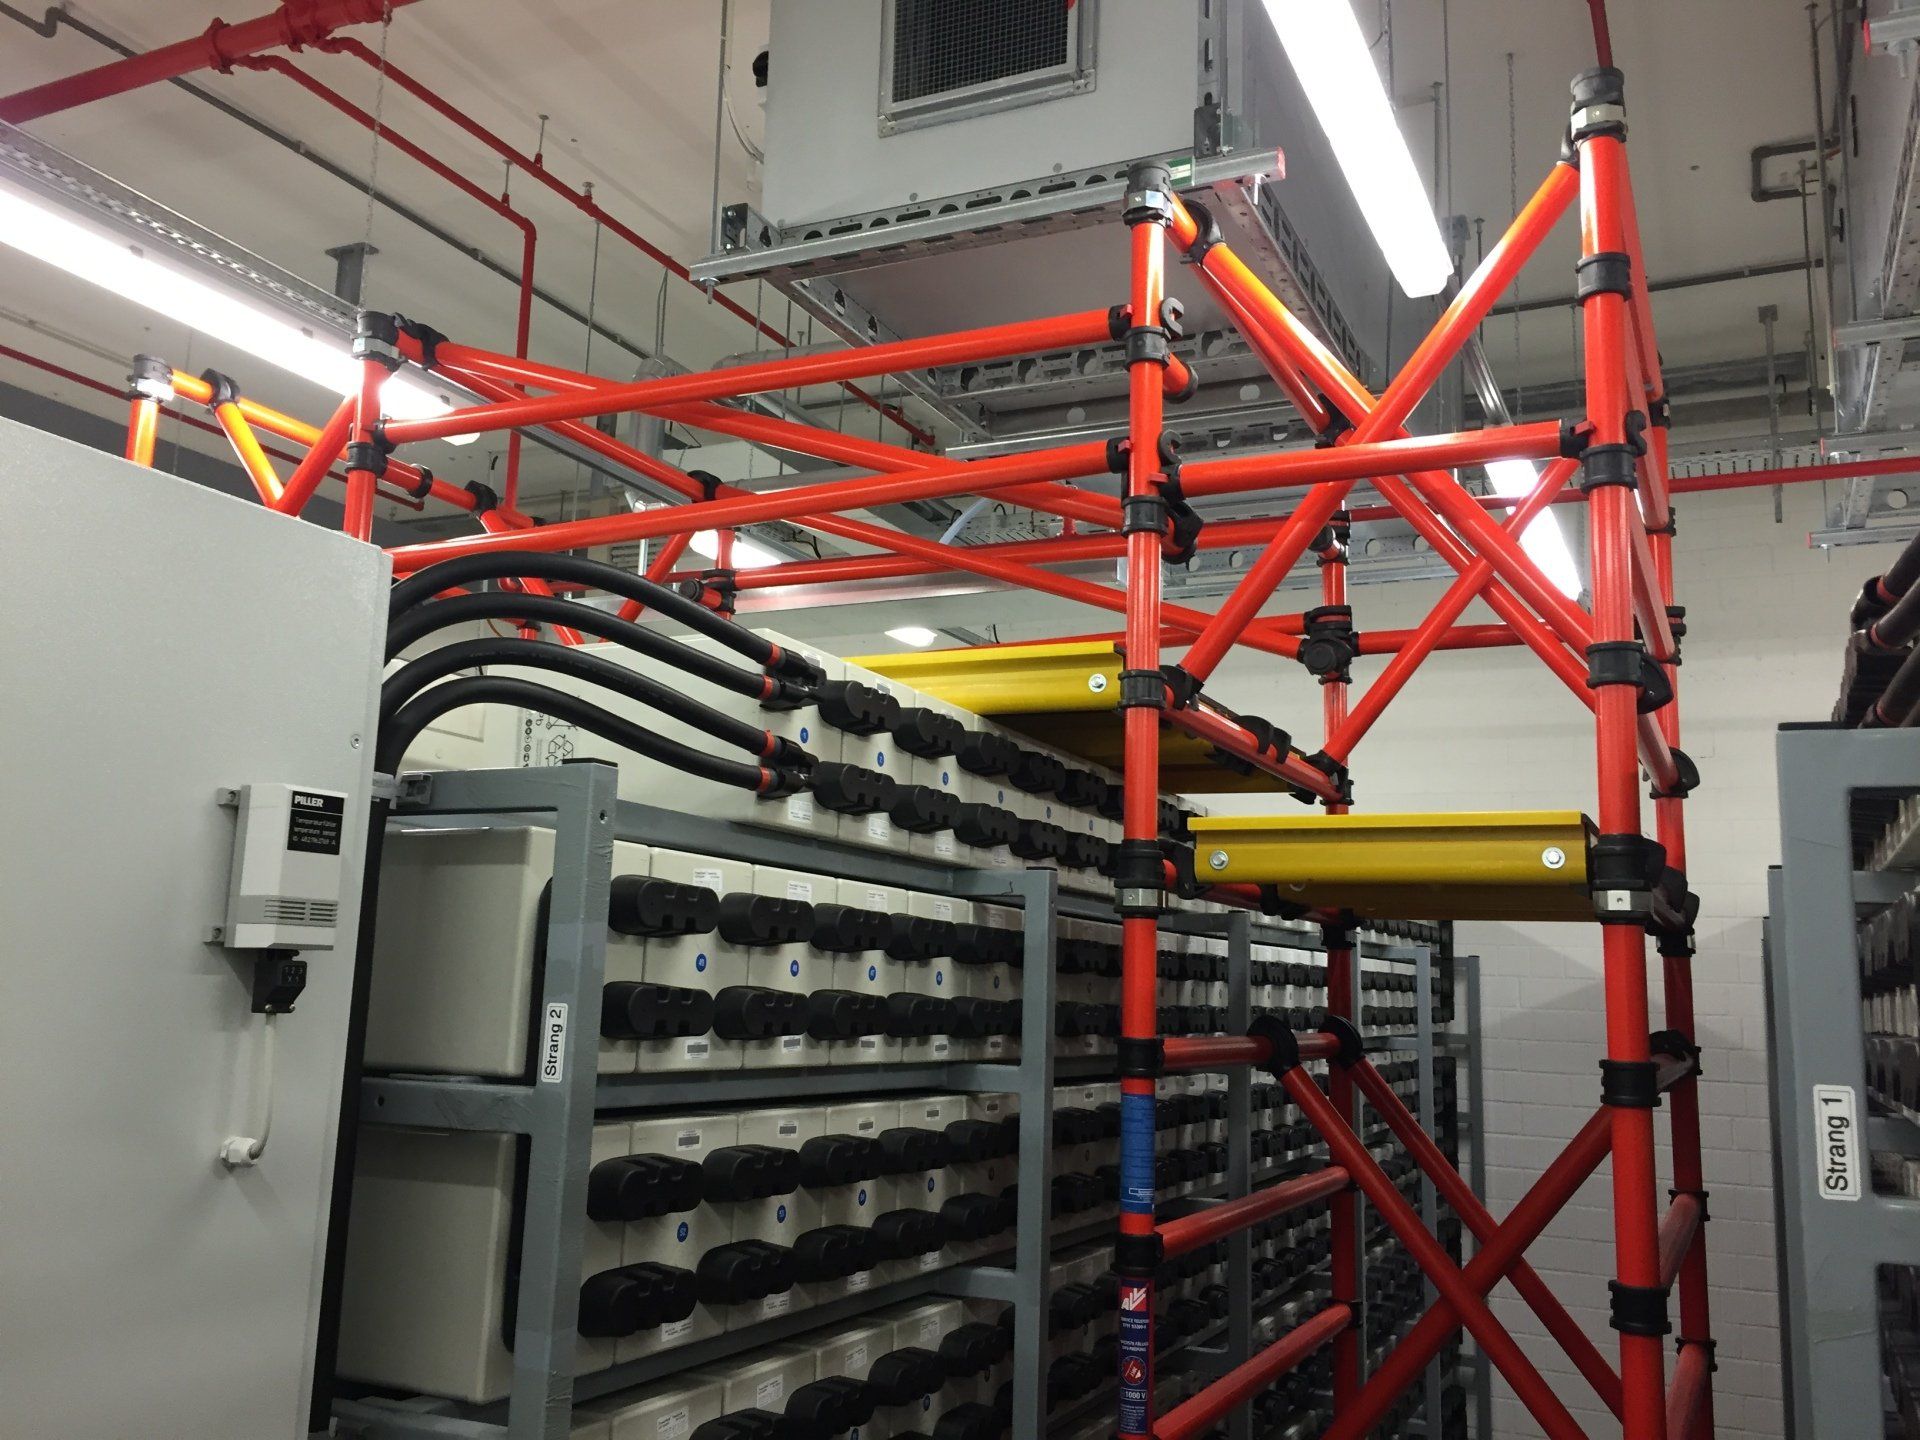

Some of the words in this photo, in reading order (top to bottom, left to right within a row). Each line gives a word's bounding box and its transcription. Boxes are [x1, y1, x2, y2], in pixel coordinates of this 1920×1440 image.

[294, 795, 324, 807] PILLER
[550, 1009, 562, 1019] 2
[545, 1024, 563, 1076] Strang
[1821, 1097, 1843, 1106] 1
[1825, 1116, 1850, 1191] Strang
